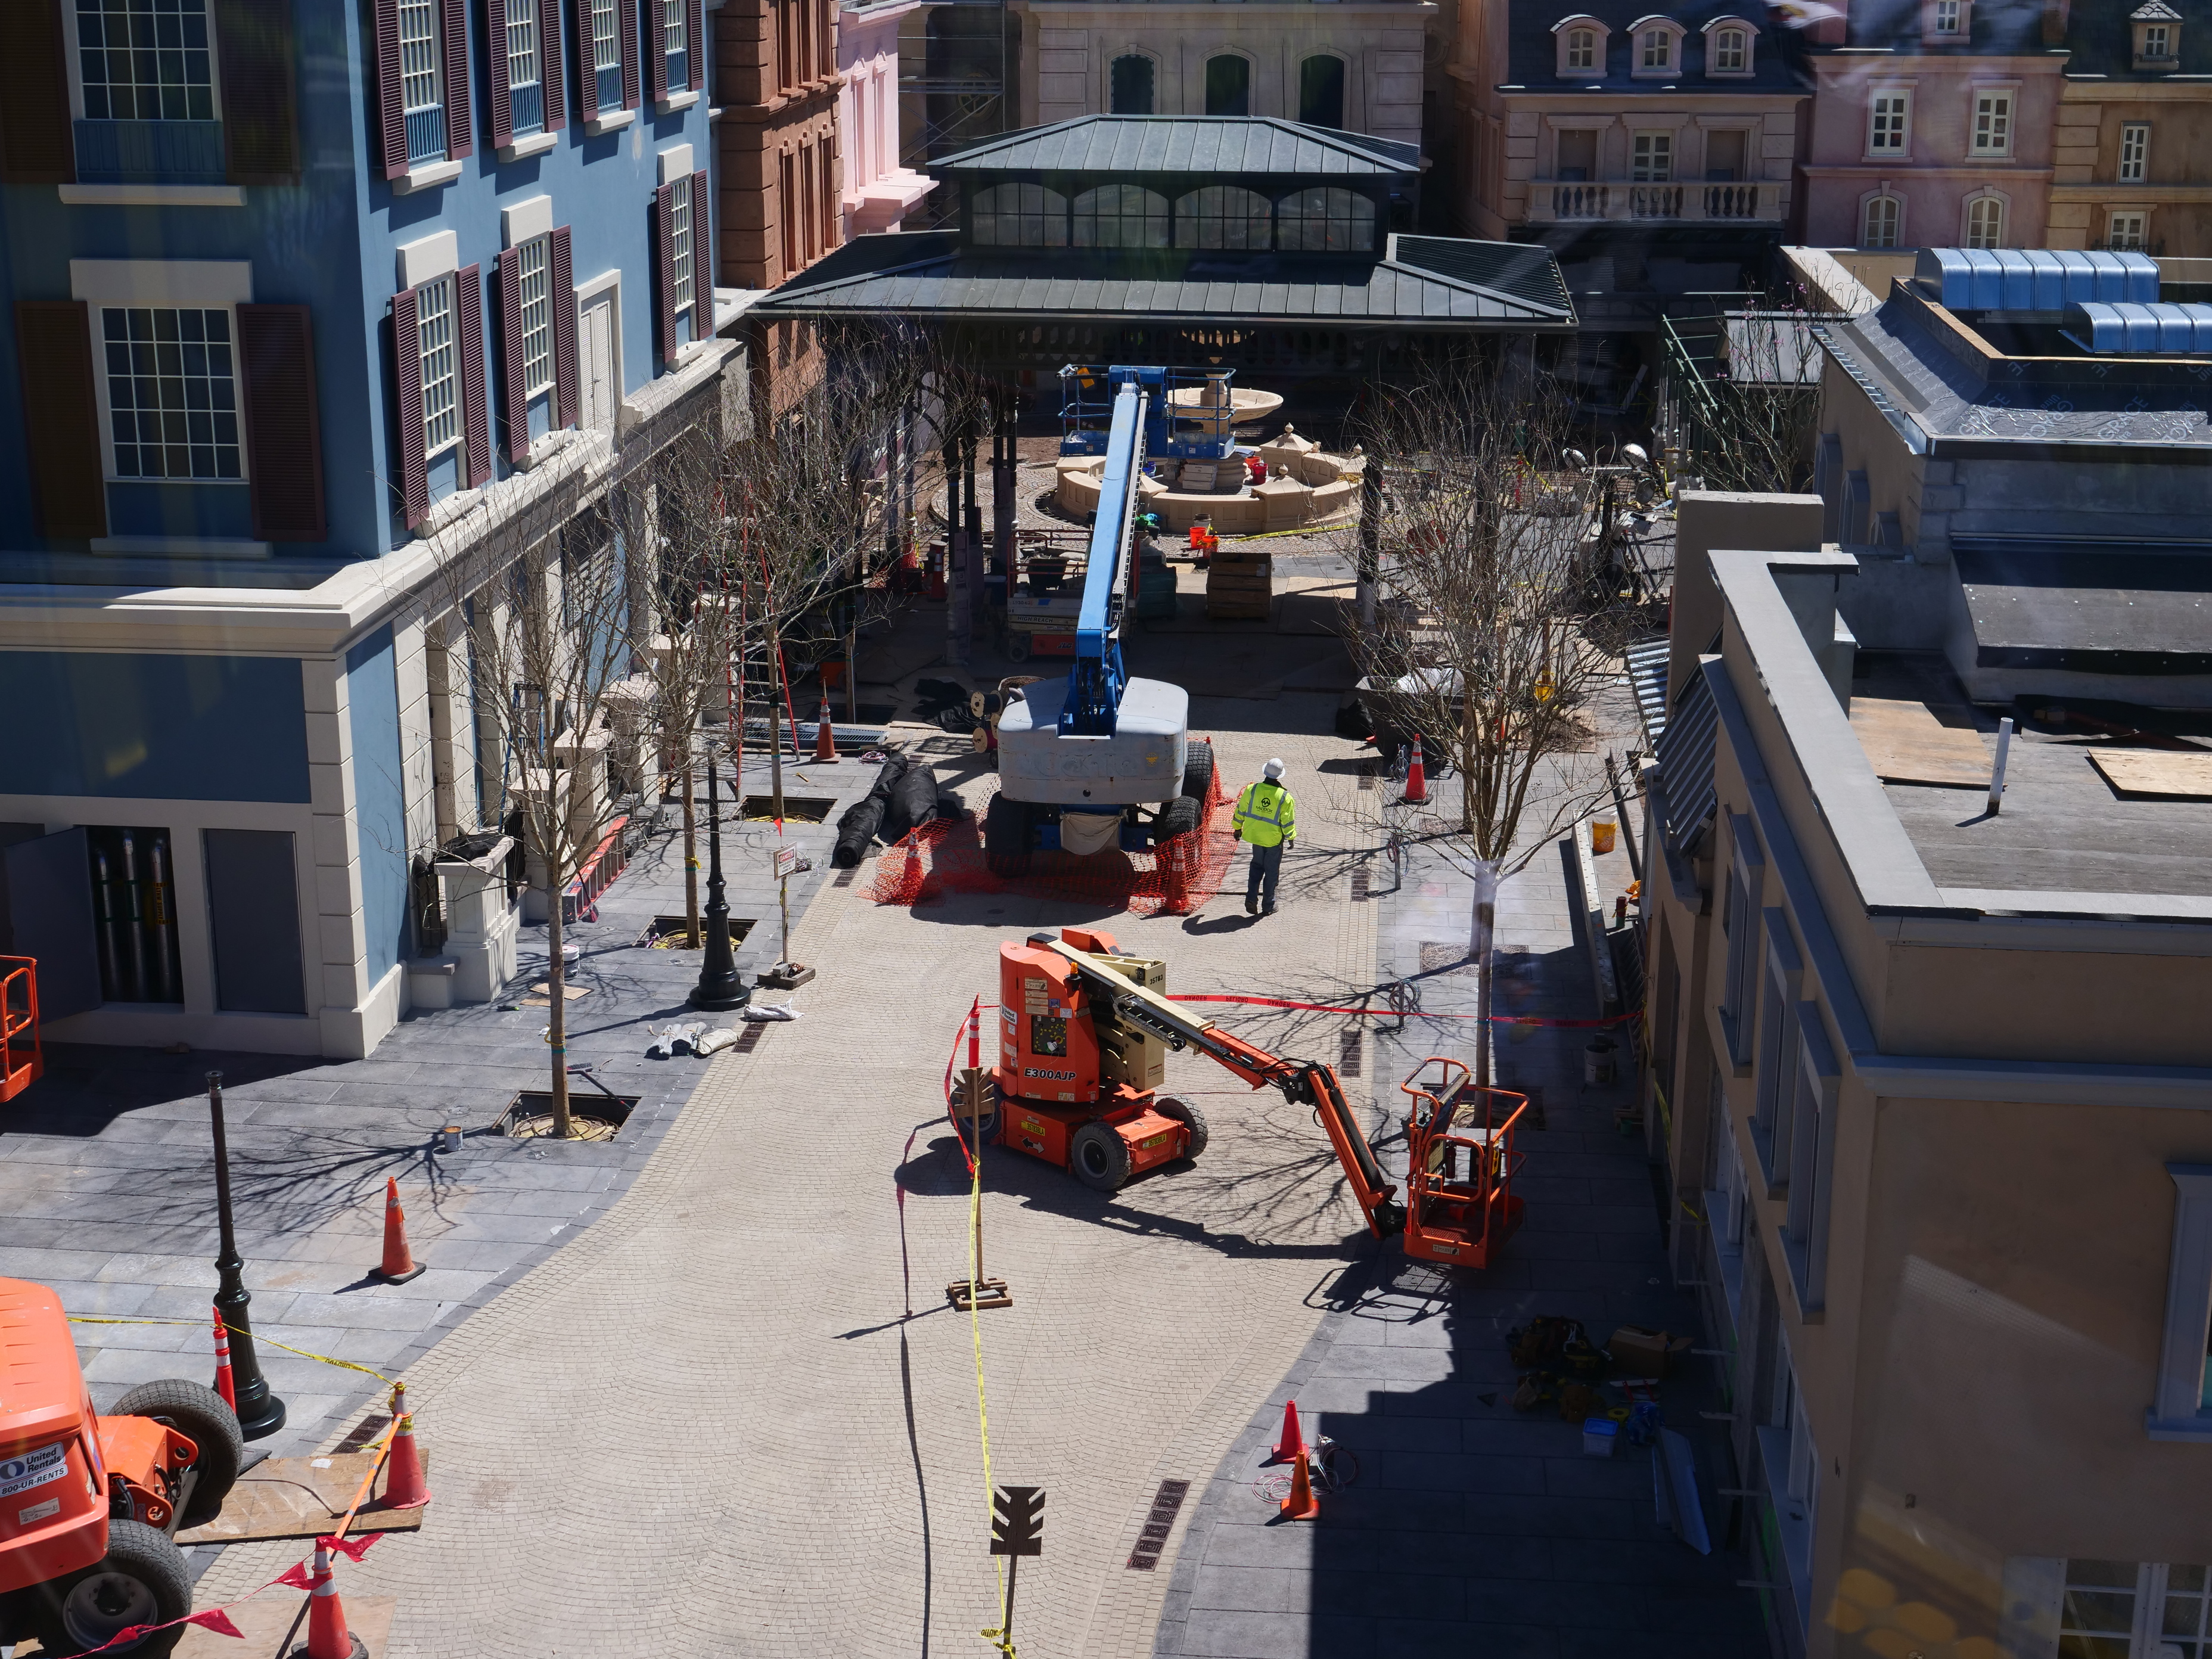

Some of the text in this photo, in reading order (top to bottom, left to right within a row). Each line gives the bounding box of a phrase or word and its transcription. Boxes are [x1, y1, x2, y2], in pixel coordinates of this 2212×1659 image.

[1150, 974, 1163, 985] 35783
[1004, 1008, 1015, 1017] United
[1024, 1067, 1077, 1082] E300AJP
[1027, 1123, 1045, 1136] 35783BLA
[1148, 1135, 1166, 1147] 35783BLA
[27, 1447, 57, 1465] United
[28, 1455, 61, 1472] Rentals
[2, 1467, 64, 1495] 800-UR-RENTS
